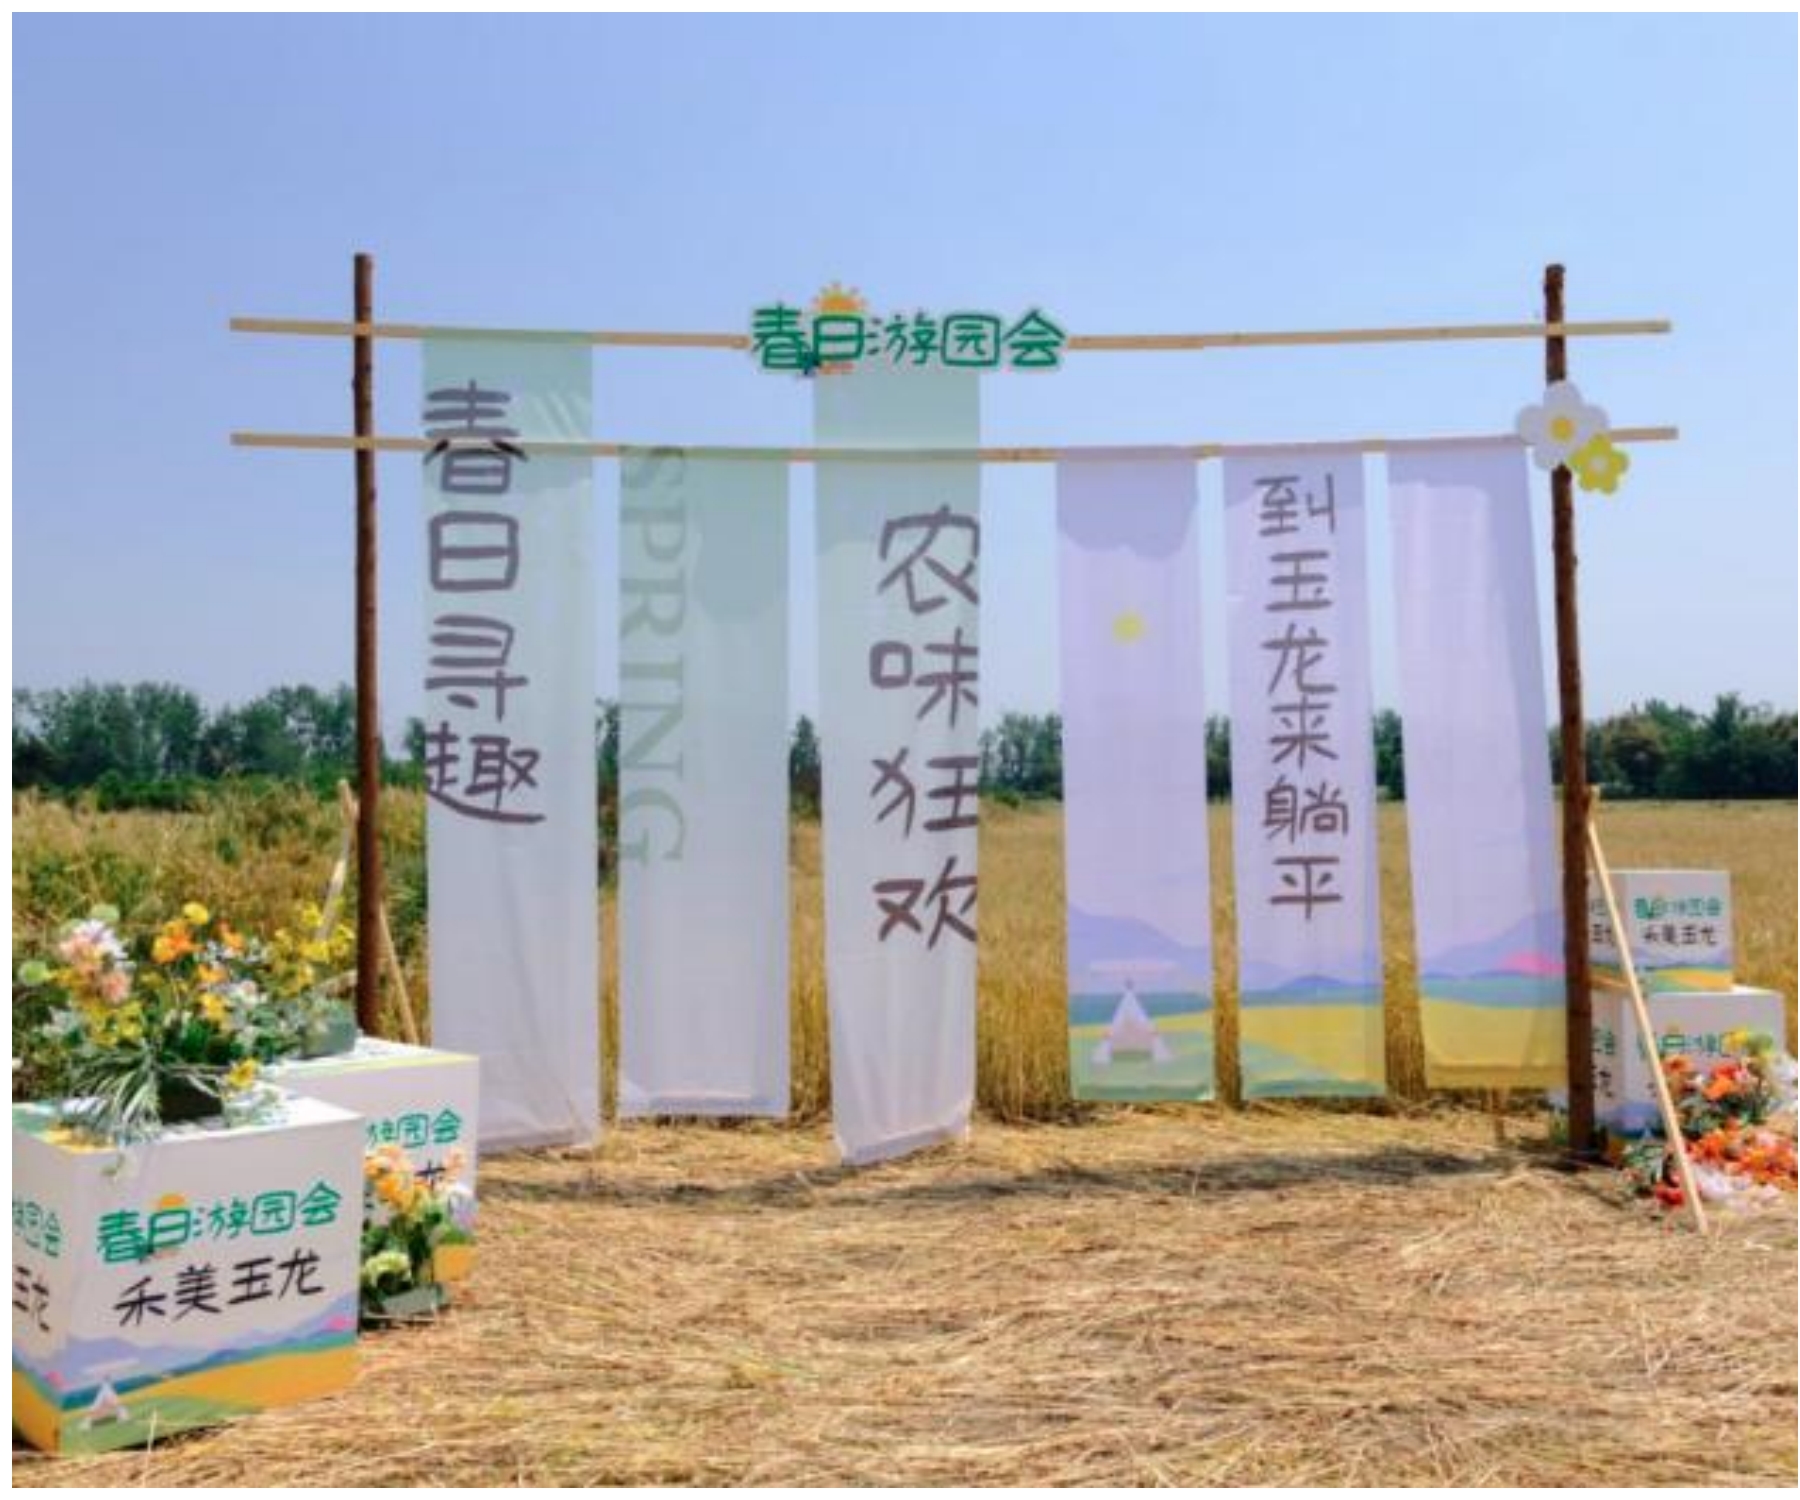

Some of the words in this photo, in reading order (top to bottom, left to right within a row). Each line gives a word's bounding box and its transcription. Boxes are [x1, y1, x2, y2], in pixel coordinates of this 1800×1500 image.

[751, 301, 1066, 371] 春日游园会
[422, 378, 547, 824] 春日寻趣
[619, 446, 686, 866] SPRING
[868, 504, 979, 950] 农味狂欢
[1253, 472, 1352, 920] 到玉龙来躺平
[95, 1180, 342, 1264] 春日游园会
[112, 1246, 325, 1327] 禾美玉龙
